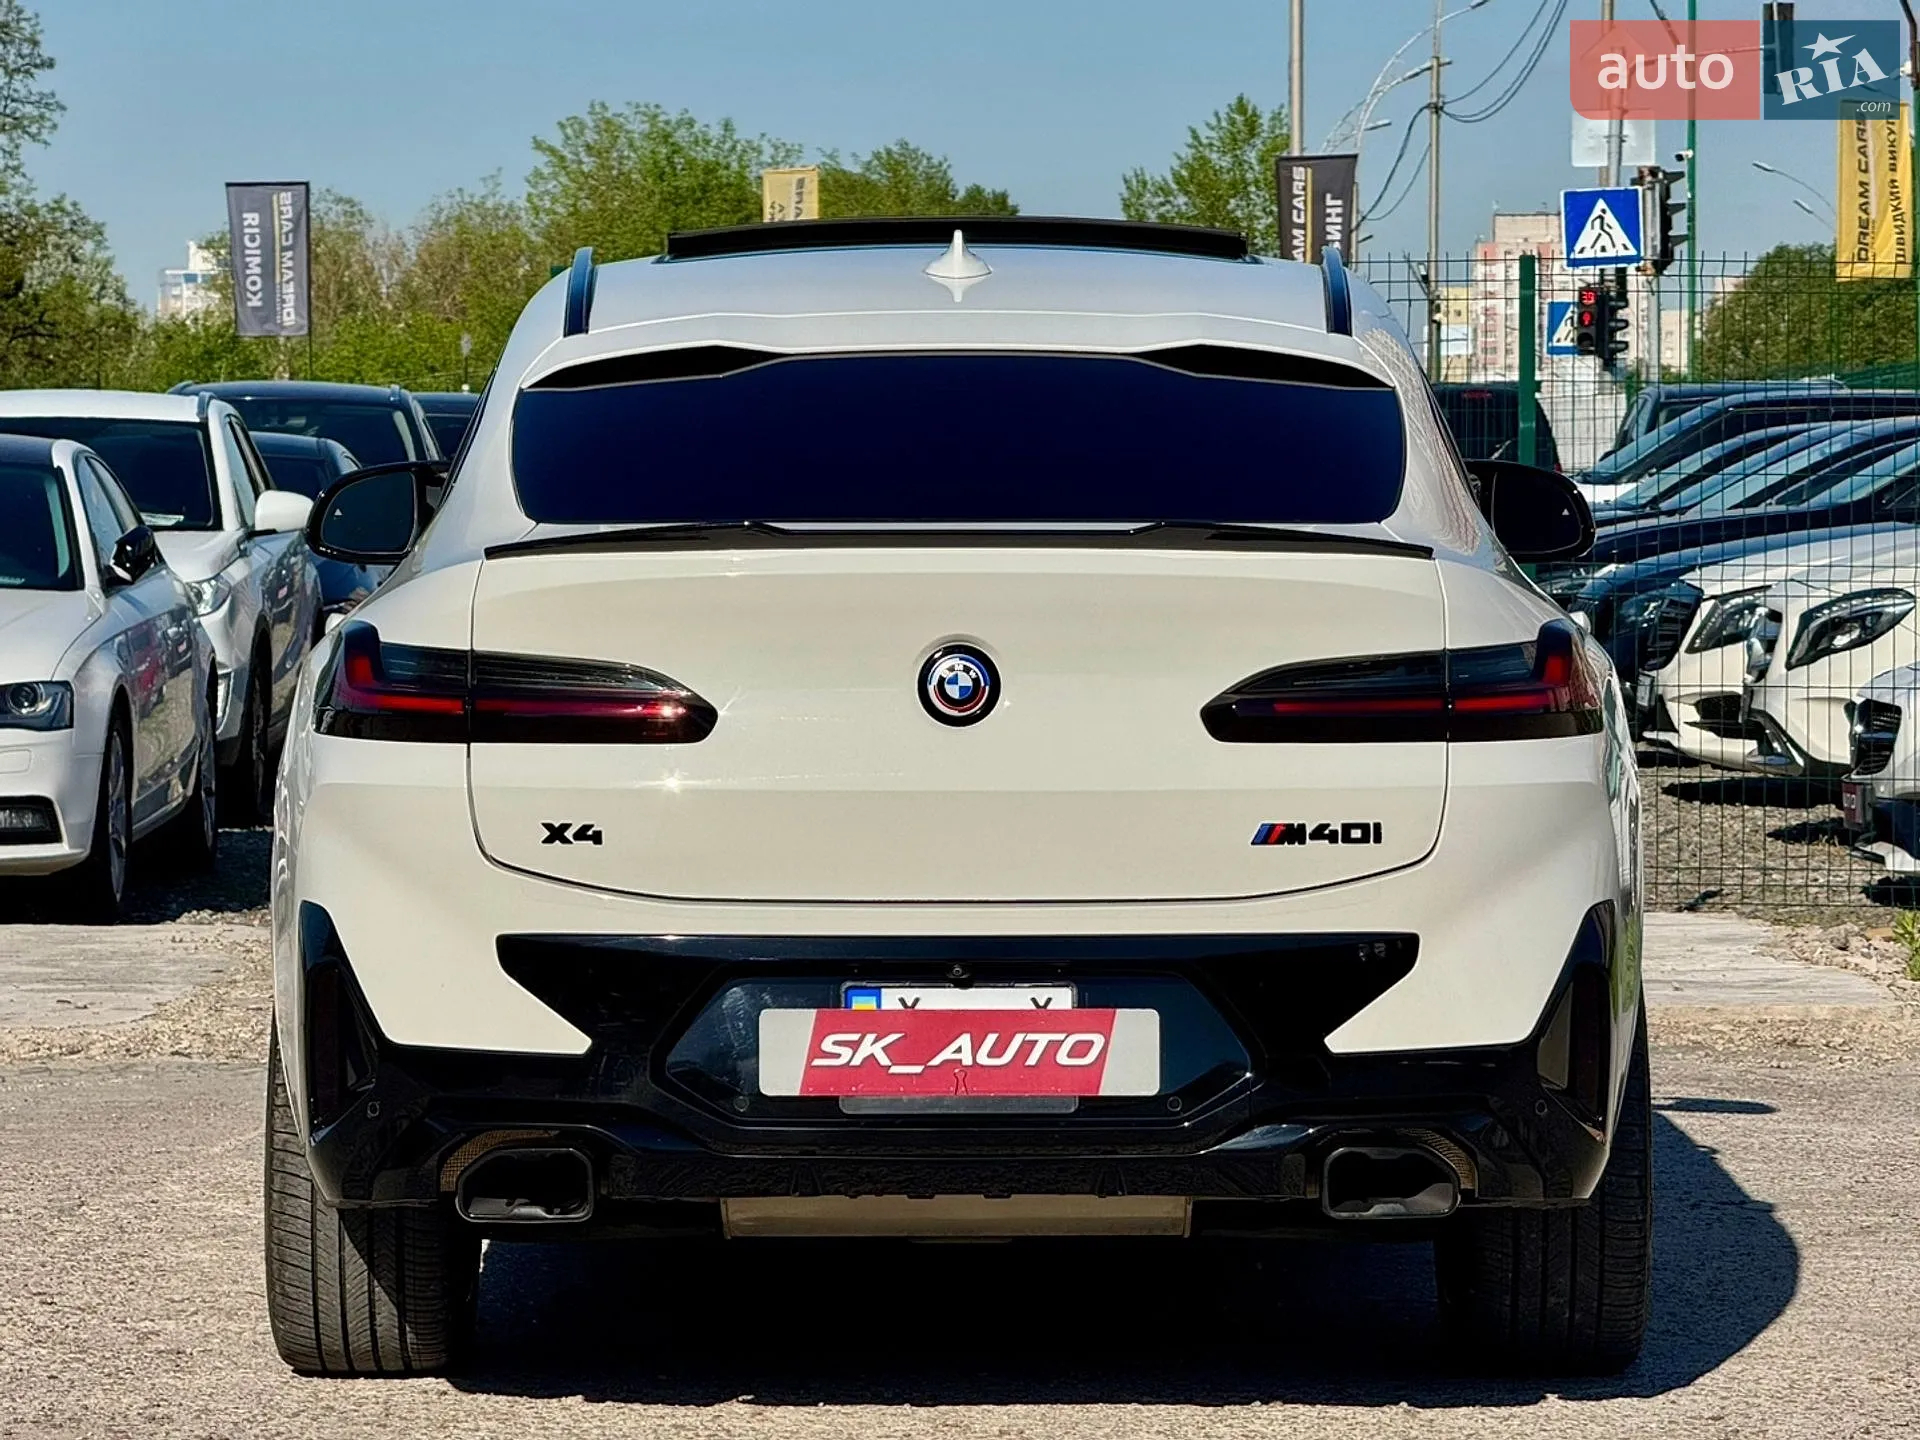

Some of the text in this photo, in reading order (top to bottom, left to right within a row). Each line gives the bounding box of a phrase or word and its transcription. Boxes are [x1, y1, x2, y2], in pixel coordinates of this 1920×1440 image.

[1292, 166, 1305, 224] CARS
[1857, 180, 1871, 262] DREAM
[541, 822, 603, 845] X4
[811, 1032, 1106, 1074] SK_AUTO
